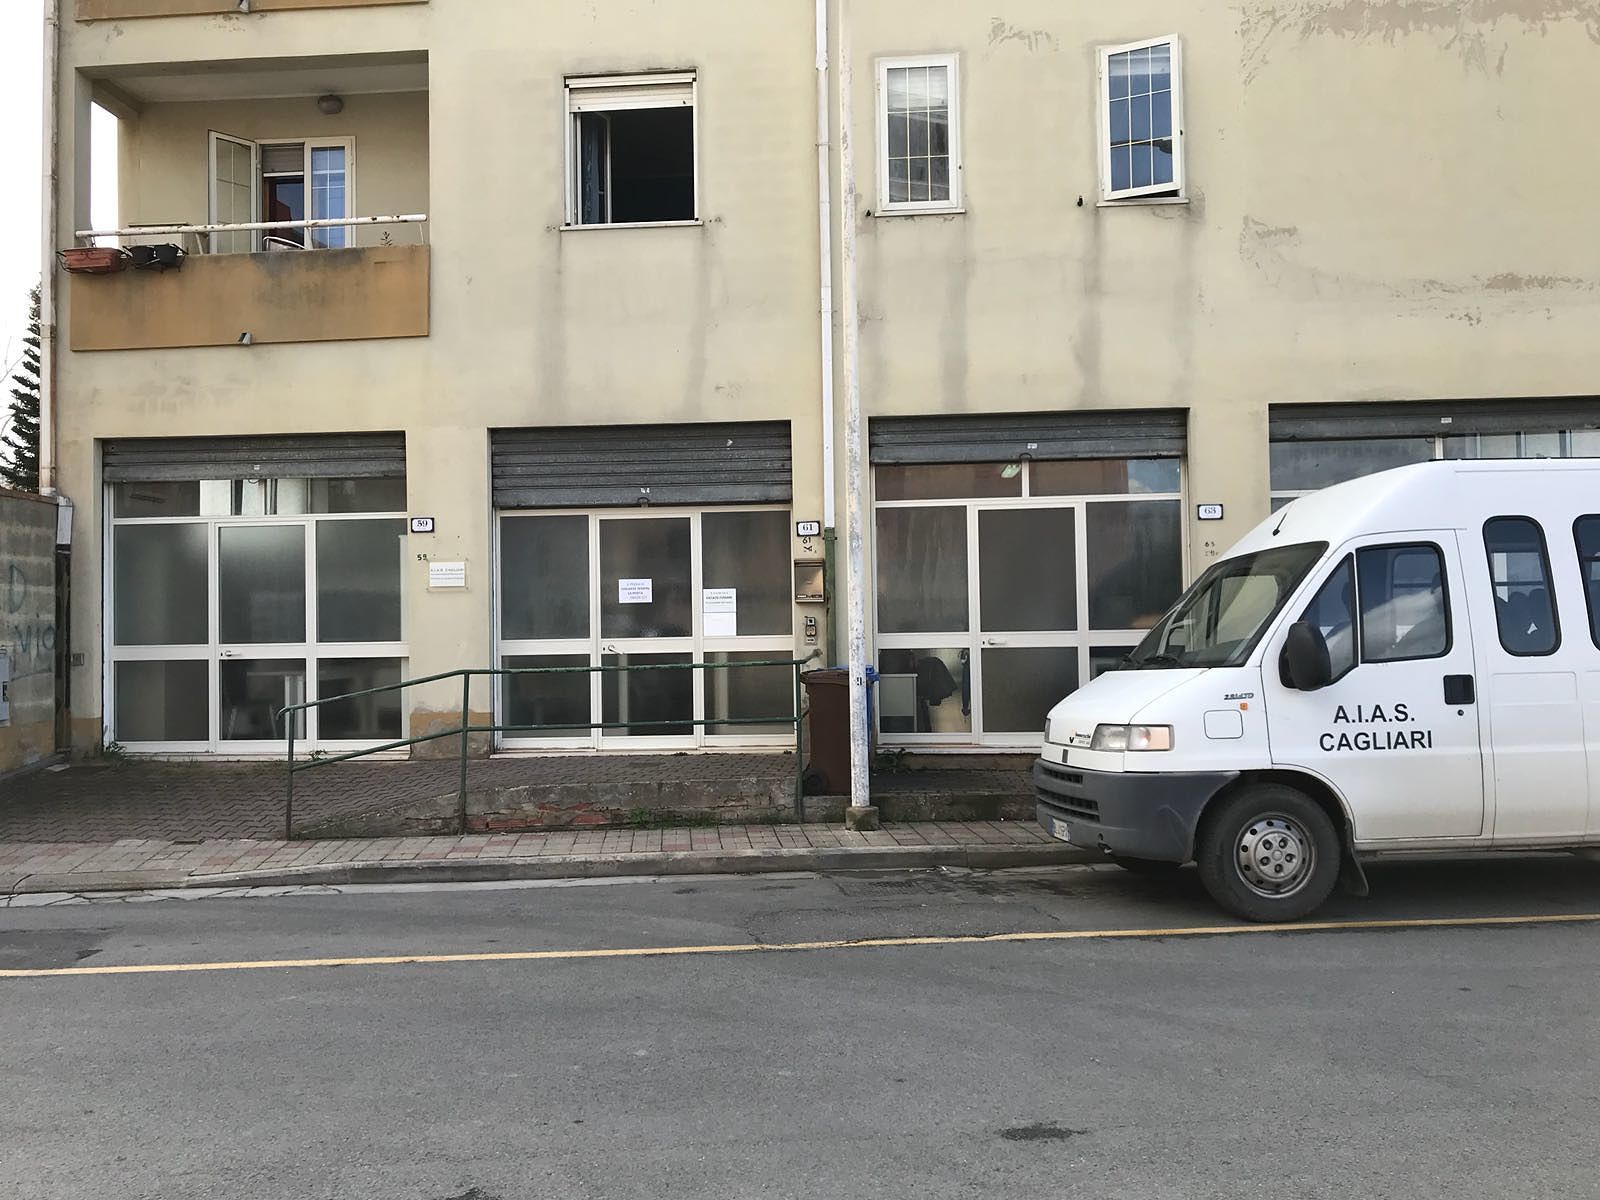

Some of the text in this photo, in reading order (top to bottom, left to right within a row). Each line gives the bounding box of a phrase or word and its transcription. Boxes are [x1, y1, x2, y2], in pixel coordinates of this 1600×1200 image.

[417, 519, 428, 528] 59
[802, 523, 813, 532] 61
[1332, 703, 1415, 724] A.I.A.S.
[1319, 730, 1433, 752] CAGLIARI
